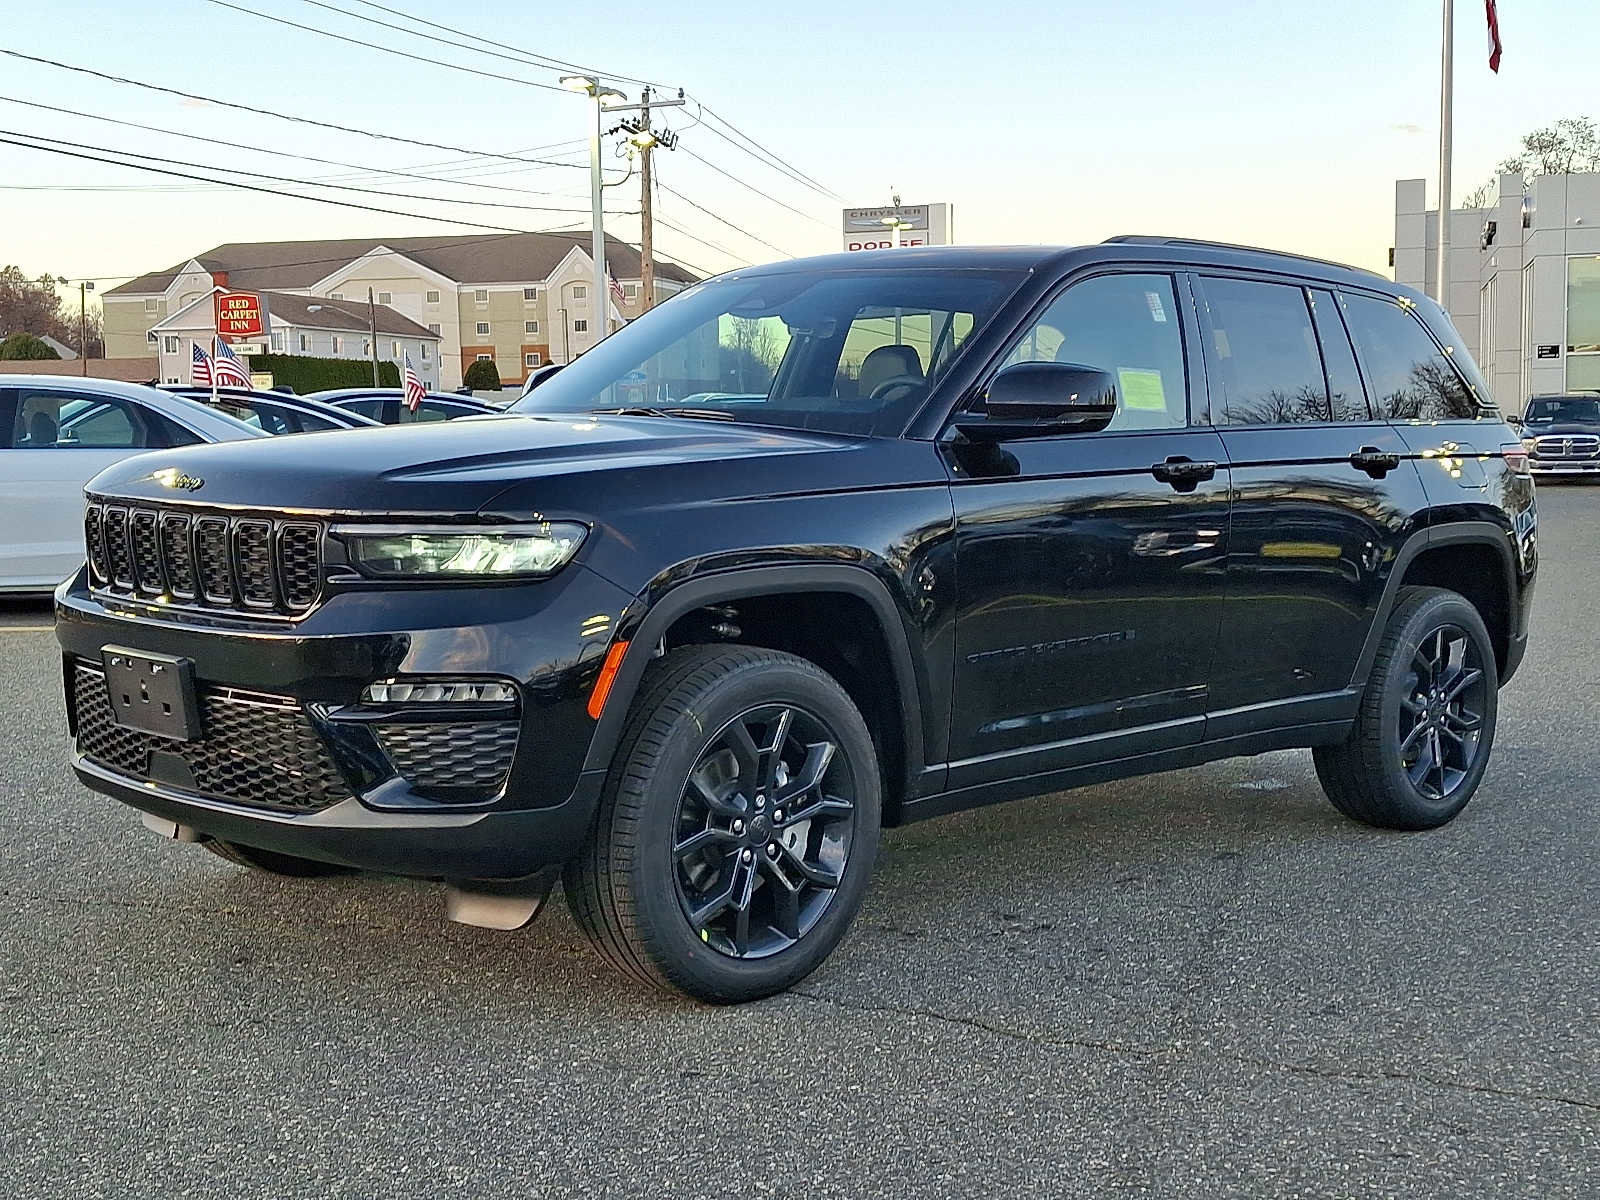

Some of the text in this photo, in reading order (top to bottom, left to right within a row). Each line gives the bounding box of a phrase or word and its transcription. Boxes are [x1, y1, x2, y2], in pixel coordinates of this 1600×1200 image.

[228, 299, 249, 309] RED
[221, 309, 257, 320] CARPET
[230, 320, 249, 330] INN
